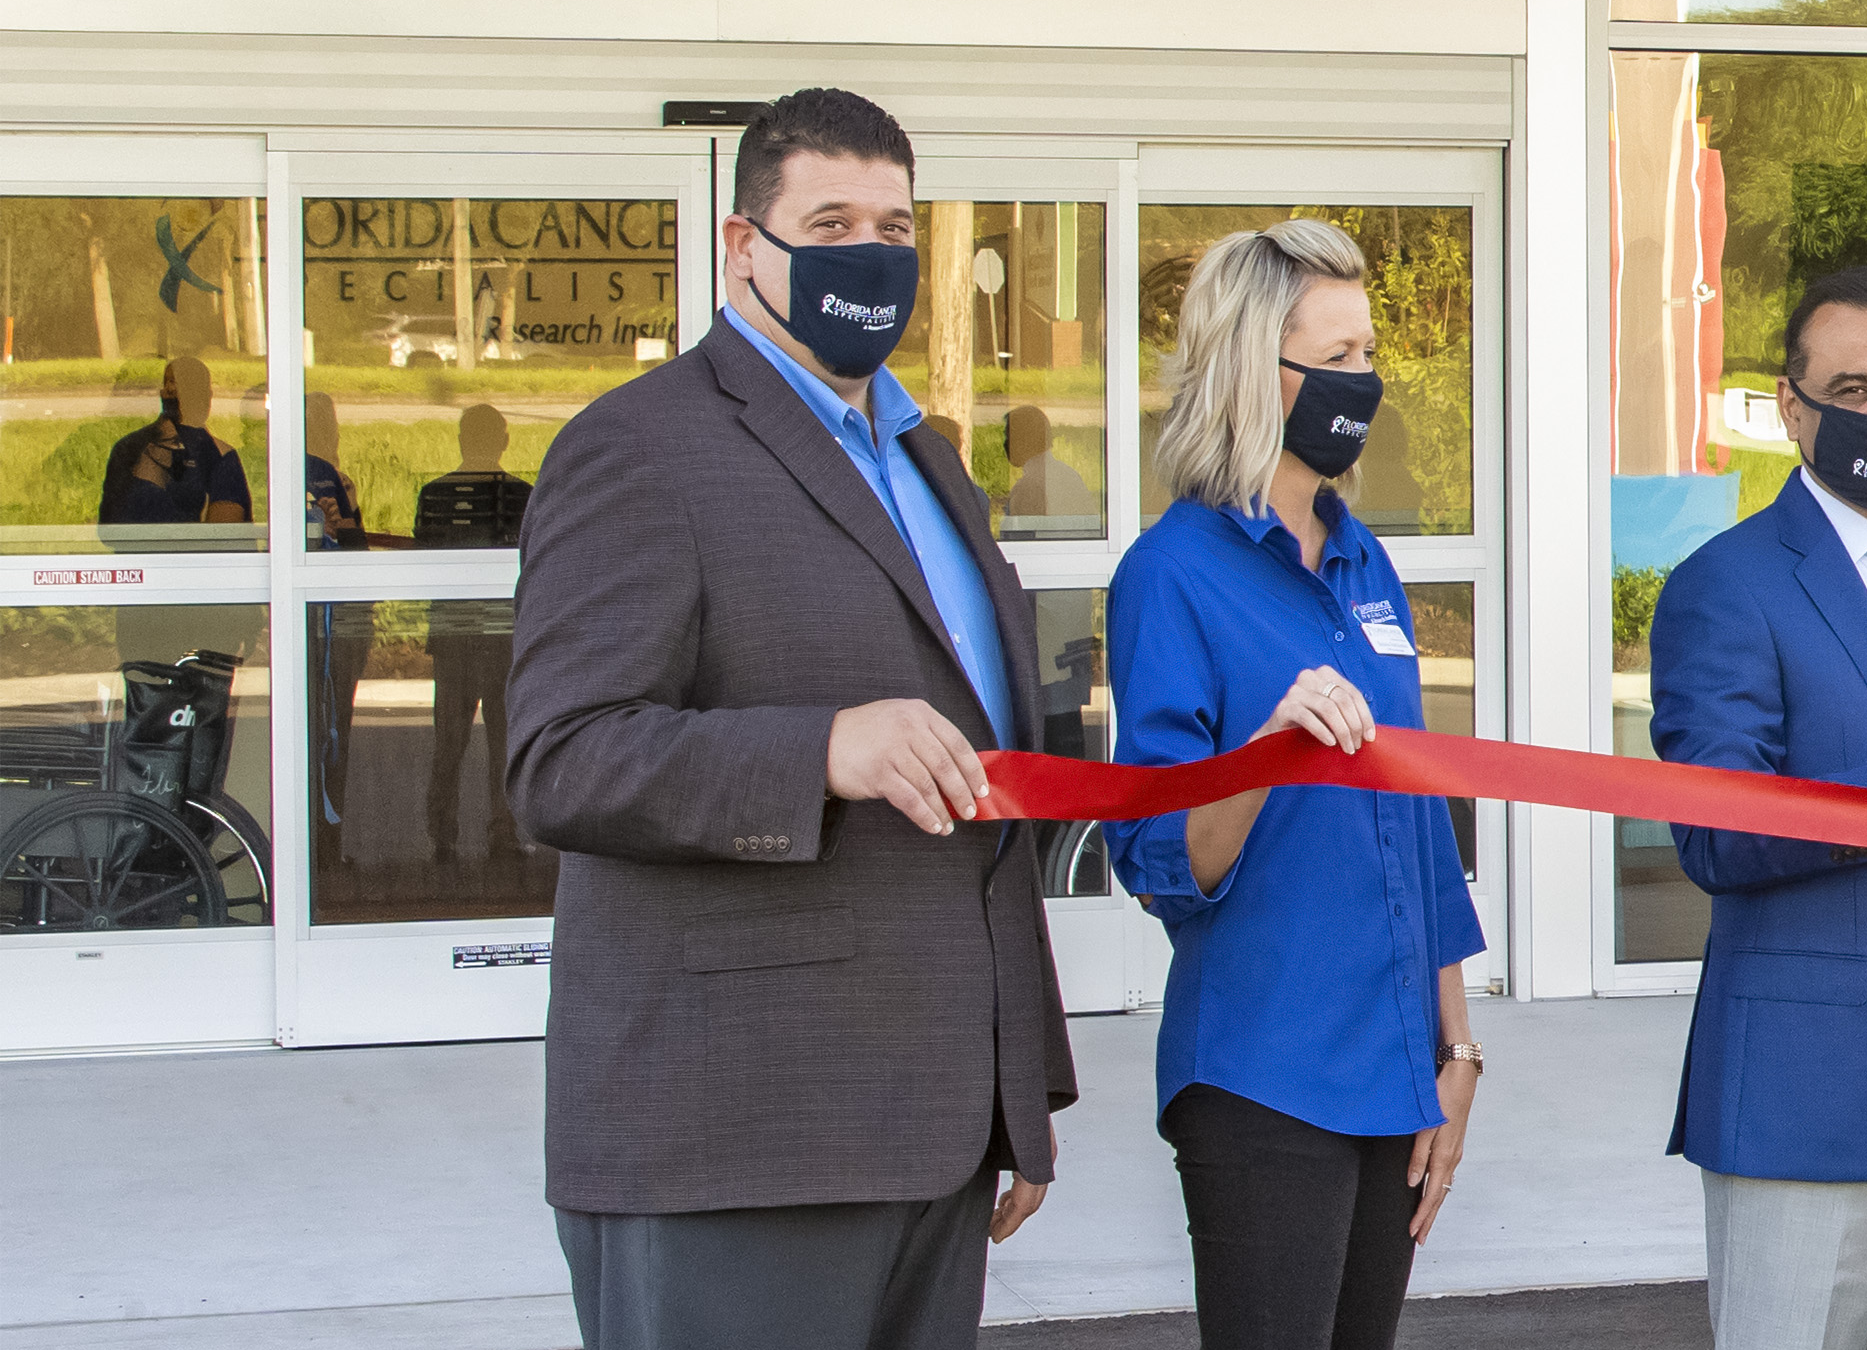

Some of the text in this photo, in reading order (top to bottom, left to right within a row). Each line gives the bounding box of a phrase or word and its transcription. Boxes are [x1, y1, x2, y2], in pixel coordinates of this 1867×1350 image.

[835, 299, 871, 315] FLORIDA
[35, 570, 142, 584] CAUTION STAND BACK
